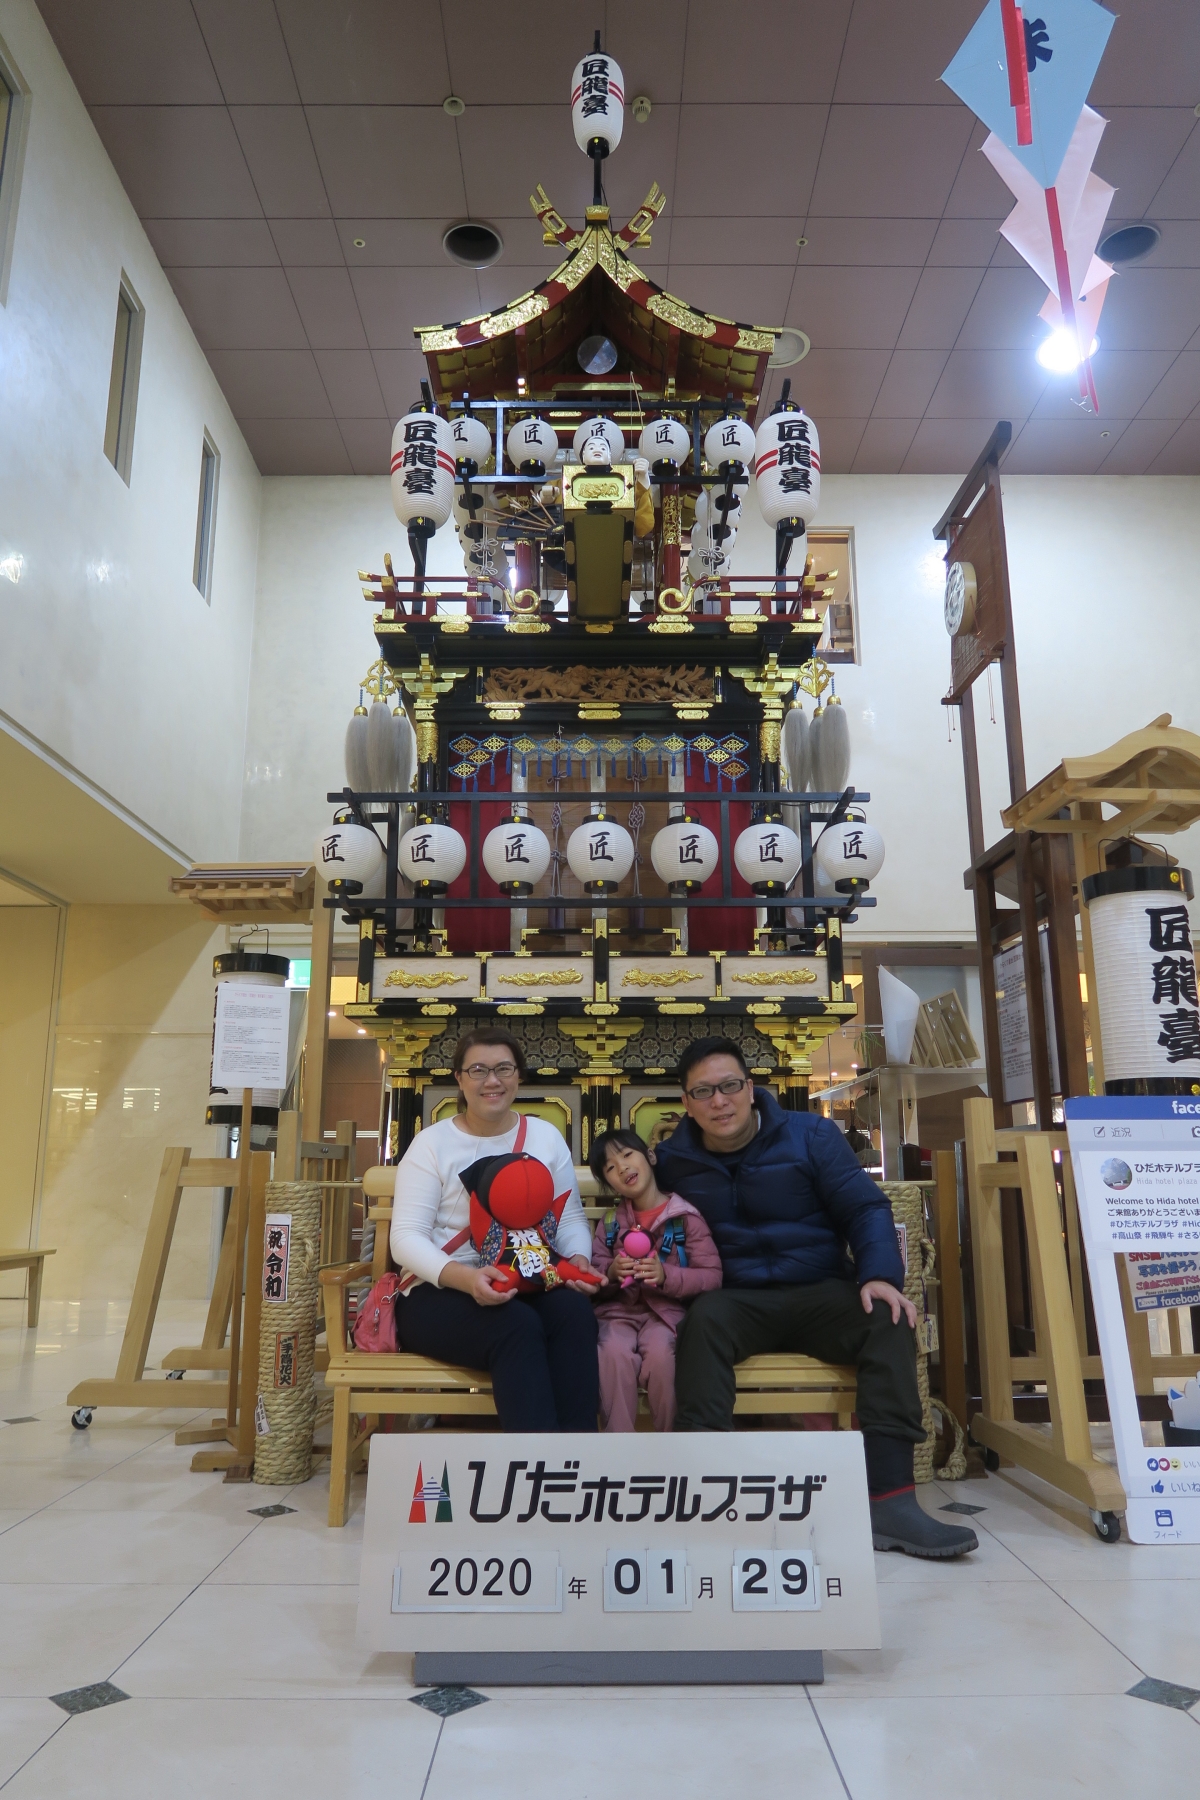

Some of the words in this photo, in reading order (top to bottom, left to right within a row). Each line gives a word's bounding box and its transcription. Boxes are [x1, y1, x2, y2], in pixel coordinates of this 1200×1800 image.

[524, 423, 543, 445] 匠
[656, 423, 674, 445] 匠
[722, 424, 741, 447] 匠
[322, 834, 345, 863] 匠
[411, 834, 435, 863] 匠
[505, 833, 530, 863] 匠
[589, 831, 614, 862] 匠
[679, 834, 703, 864] 匠
[759, 833, 783, 863] 匠
[843, 830, 867, 860] 匠
[1111, 1127, 1132, 1138] 近況
[467, 1460, 827, 1523] ひだホテルプラザ
[428, 1557, 533, 1597] 2020
[568, 1577, 588, 1599] 年
[613, 1558, 675, 1595] 01
[697, 1577, 714, 1599] 月
[741, 1558, 808, 1596] 29
[826, 1578, 842, 1598] 日
